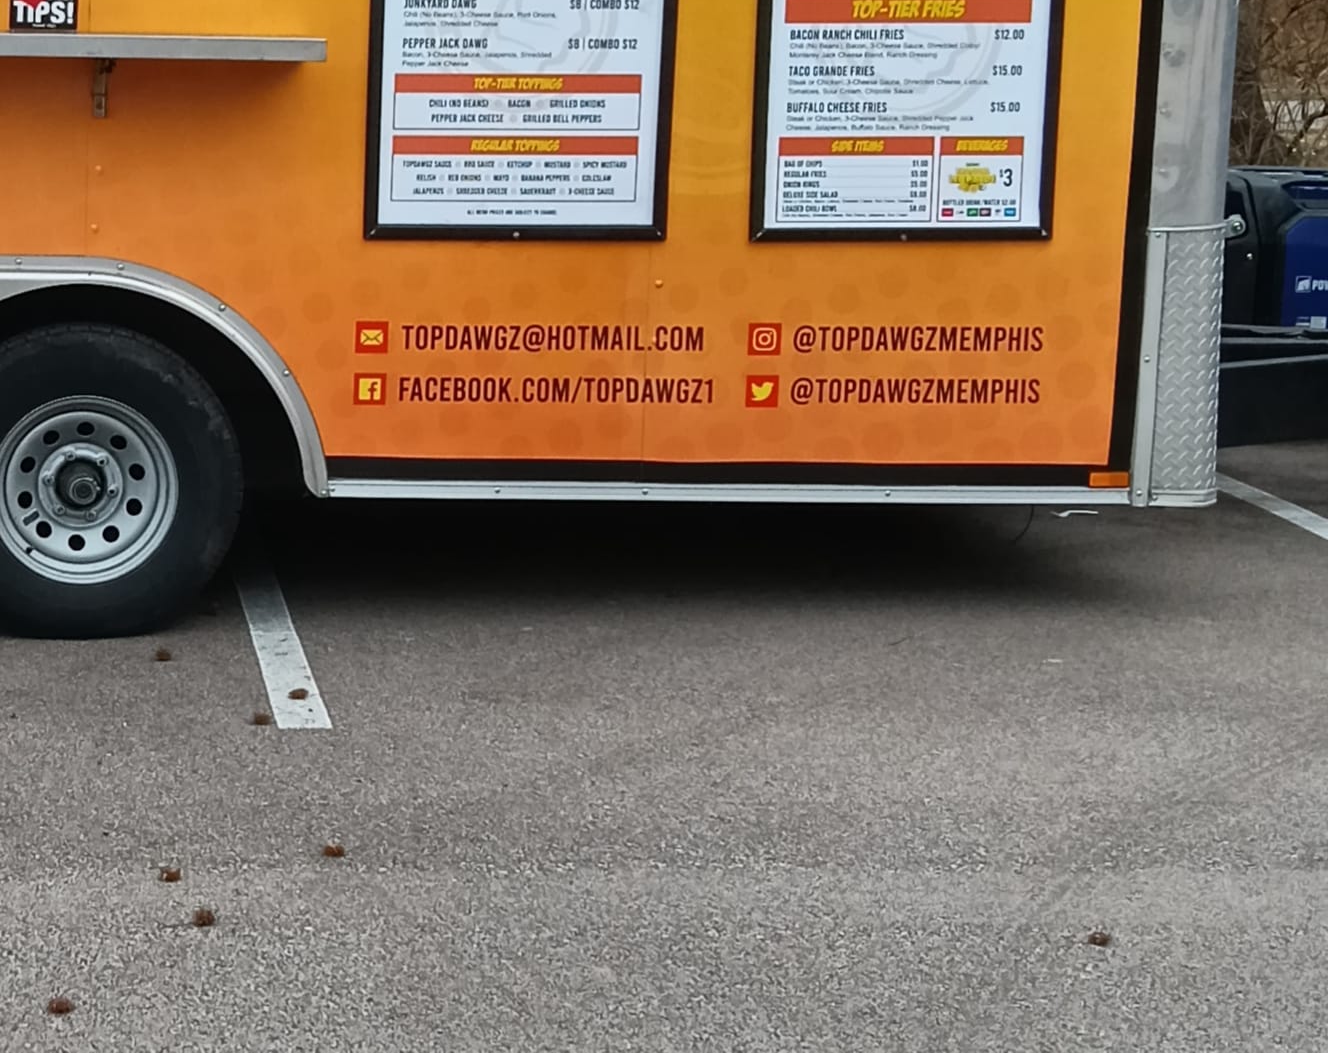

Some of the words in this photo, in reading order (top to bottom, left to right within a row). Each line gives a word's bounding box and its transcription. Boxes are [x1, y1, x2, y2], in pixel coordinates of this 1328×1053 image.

[452, 0, 476, 9] DAWG
[570, 0, 582, 9] $8
[590, 0, 622, 9] COMBO
[624, 0, 640, 10] $12
[853, 0, 920, 18] TOP-TIER
[922, 0, 965, 18] FRIES
[13, 0, 74, 24] TIPS!
[790, 30, 820, 40] BACON
[822, 30, 852, 40] RANCH
[854, 30, 877, 40] CHILI
[880, 30, 904, 40] FRIES
[995, 30, 1025, 40] $12.00
[403, 38, 436, 48] PEPPER
[439, 38, 460, 48] JACK
[462, 38, 488, 49] DAWG
[568, 39, 580, 49] $8
[588, 39, 620, 49] COMBO
[622, 40, 638, 50] $12
[789, 66, 810, 76] TACO
[813, 66, 847, 76] GRANDE
[850, 66, 875, 76] FRIES
[993, 66, 1022, 76] $15.00
[429, 100, 447, 108] CHILI
[449, 100, 463, 108] (NO
[465, 100, 489, 108] BEANS)
[508, 100, 531, 108] BACON
[550, 100, 578, 108] GRILLED
[581, 100, 605, 108] ONIONS
[787, 102, 824, 113] BUFFALO
[827, 102, 860, 113] CHEESE
[863, 102, 887, 113] FRIES
[991, 102, 1020, 113] $15.00
[431, 114, 458, 122] PEPPER
[460, 114, 476, 122] JACK
[478, 115, 503, 123] CHEESE
[523, 115, 551, 123] GRILLED
[553, 115, 569, 123] BELL
[572, 115, 602, 123] PEPPERS
[1000, 169, 1013, 186] $3
[402, 325, 704, 352] TOPDAWGZ@HOTMAIL.COM
[793, 326, 1043, 353] @TOPDAWGZMEMPHIS
[398, 377, 714, 404] FACEBOOK.COM/TOPDAWGZ1
[790, 378, 1040, 404] @TOPDAWGZMEMPHIS
